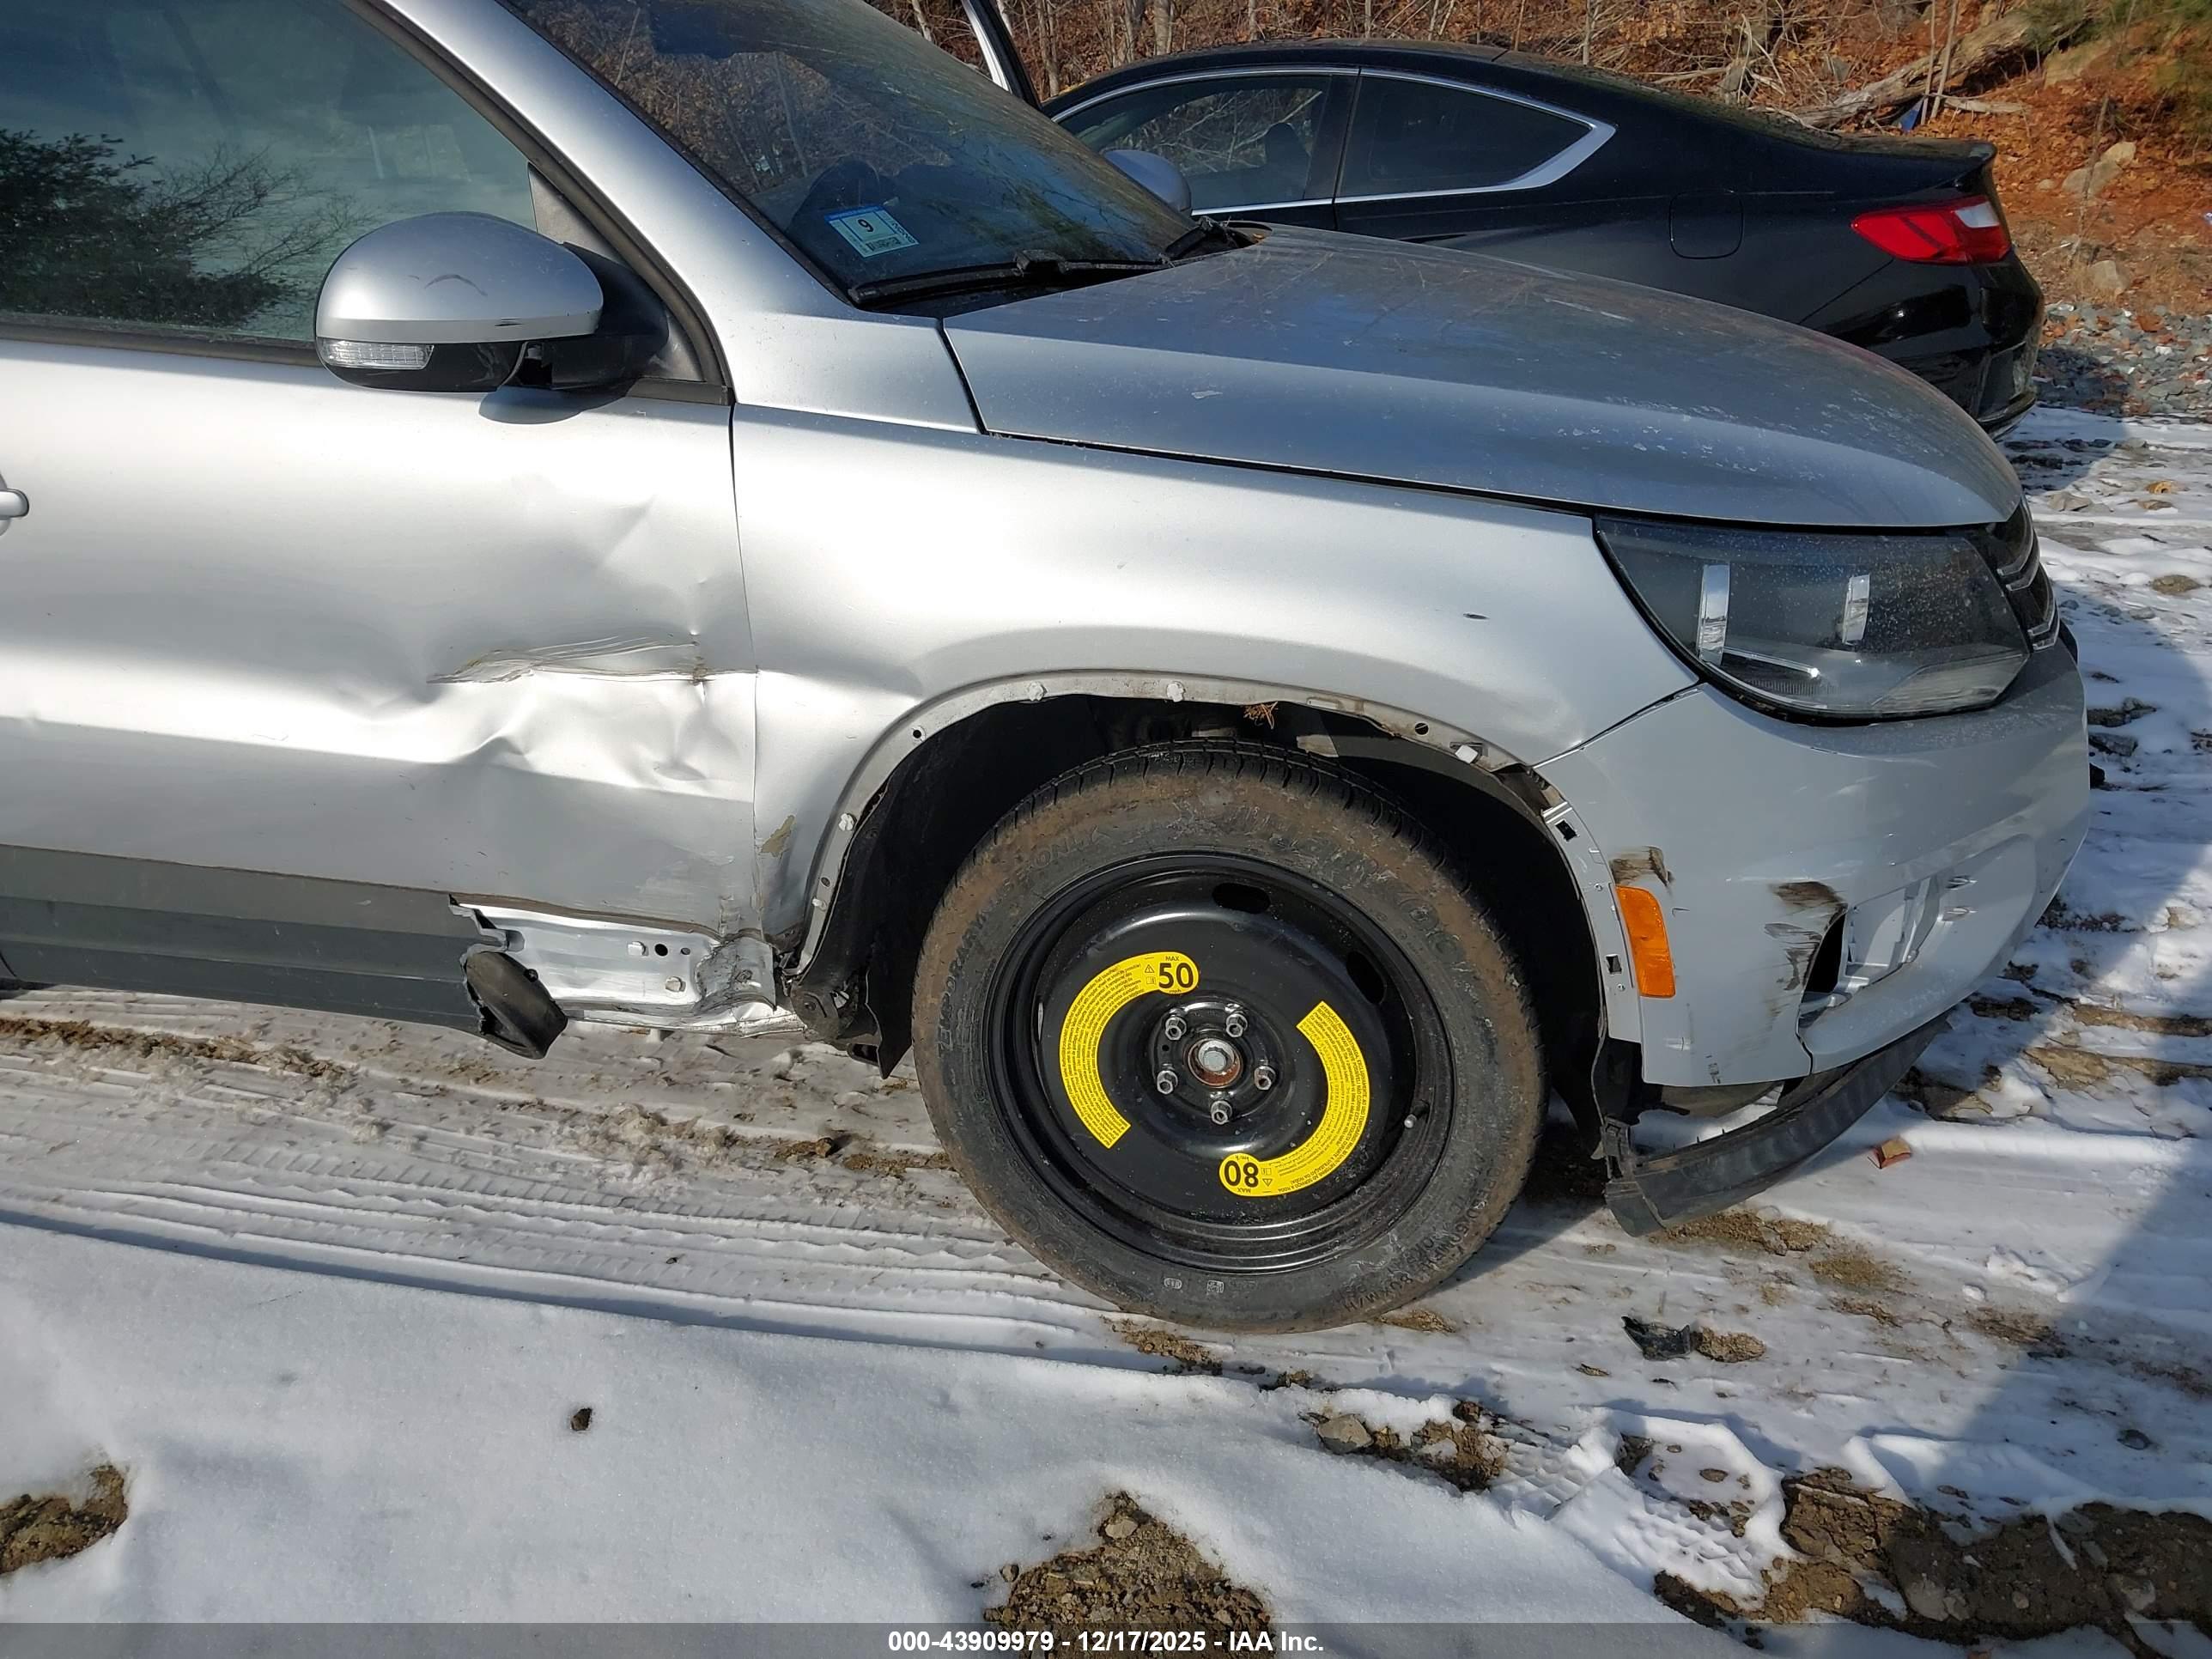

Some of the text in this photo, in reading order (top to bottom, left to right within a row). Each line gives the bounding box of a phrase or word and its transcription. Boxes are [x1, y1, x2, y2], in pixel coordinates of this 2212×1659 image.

[857, 219, 874, 233] 9
[1158, 962, 1194, 989] 50
[1224, 1159, 1259, 1188] 80
